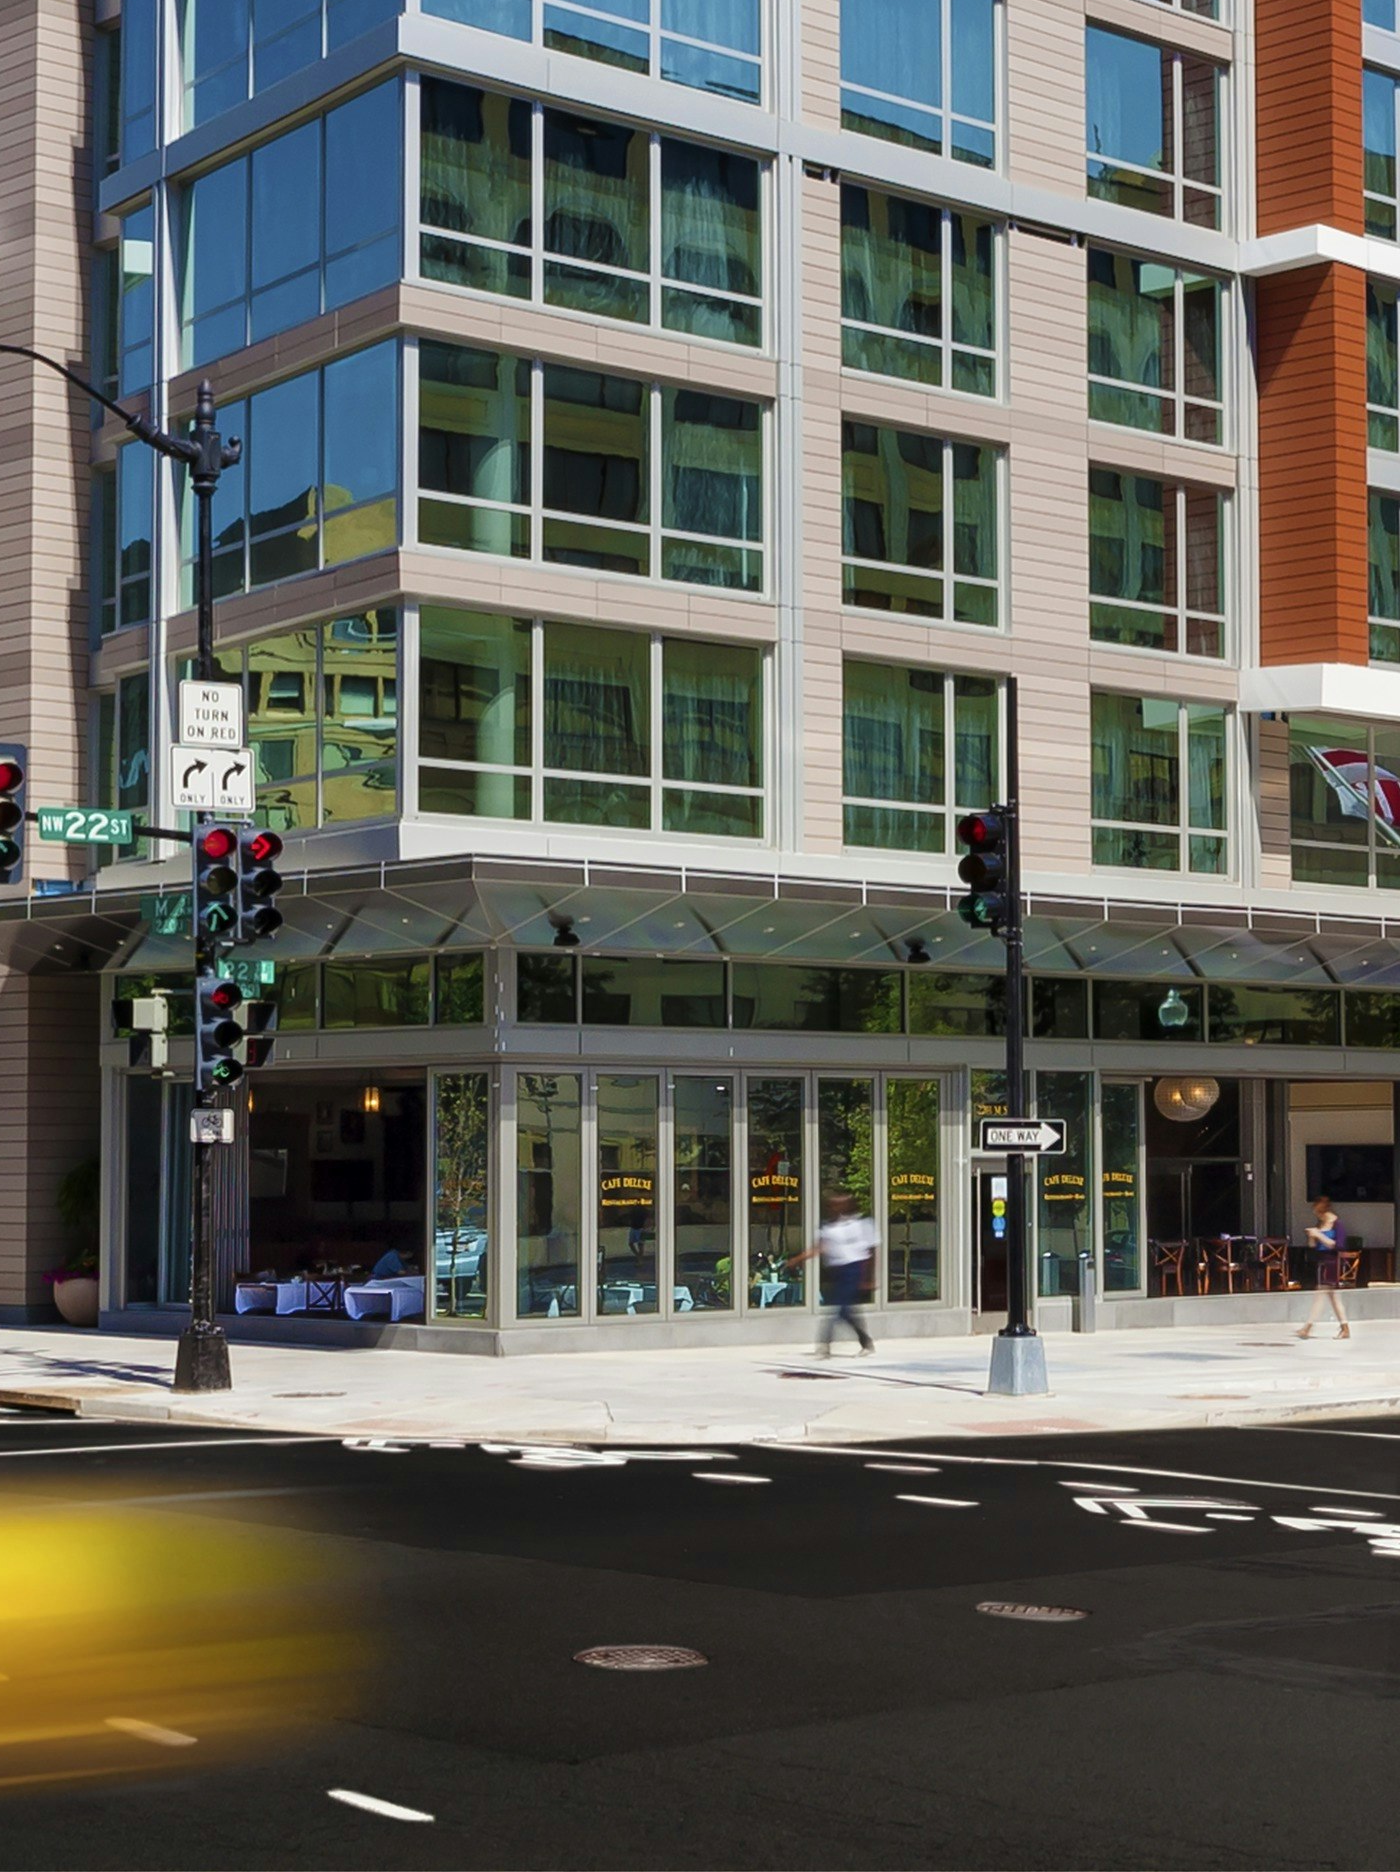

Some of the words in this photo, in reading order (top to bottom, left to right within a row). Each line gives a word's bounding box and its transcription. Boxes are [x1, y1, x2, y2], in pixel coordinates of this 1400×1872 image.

[201, 690, 219, 703] NO
[195, 708, 229, 722] TURN
[187, 725, 205, 738] ON
[210, 727, 236, 740] RED
[180, 794, 206, 804] ONLY
[220, 795, 246, 806] ONLY
[42, 815, 64, 832] NW
[65, 811, 109, 841] 22
[110, 818, 128, 836] ST
[990, 1130, 1013, 1142] ONE
[1017, 1130, 1040, 1142] WAY
